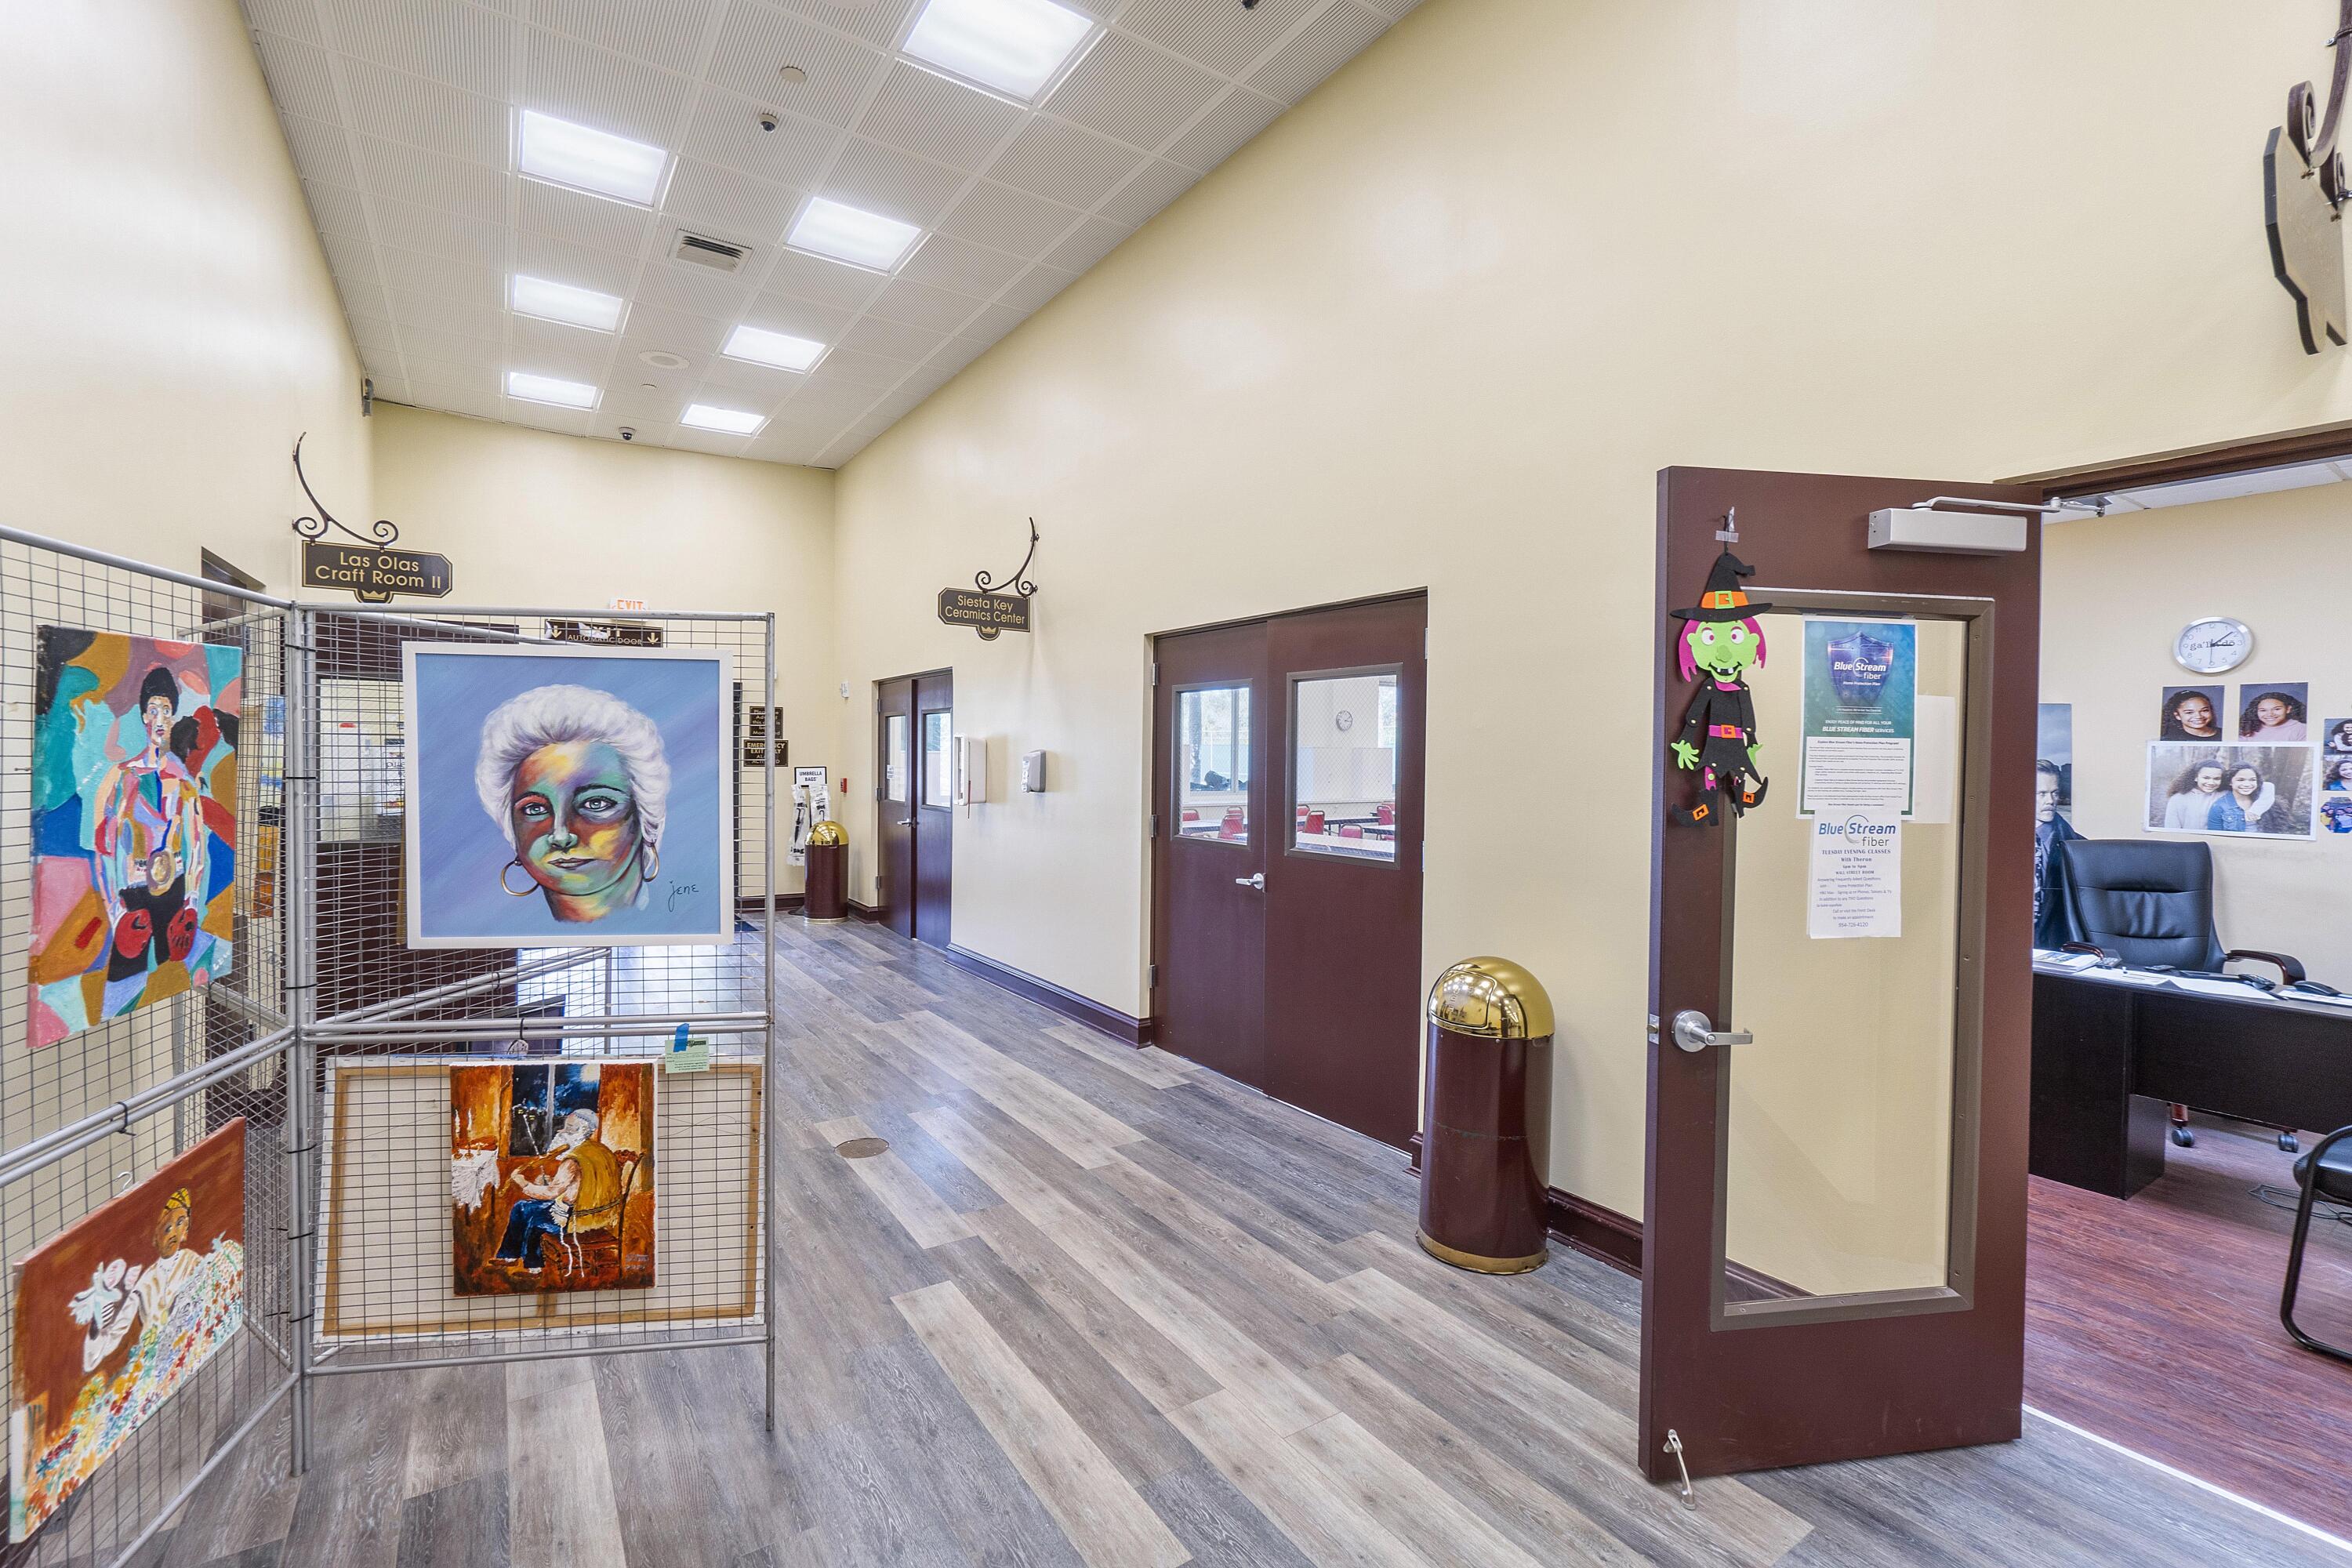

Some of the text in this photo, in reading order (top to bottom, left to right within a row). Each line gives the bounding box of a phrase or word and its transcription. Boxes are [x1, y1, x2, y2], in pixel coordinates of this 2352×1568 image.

[339, 551, 419, 572] Las Olas
[315, 565, 441, 589] Craft Room II
[957, 594, 1014, 613] Siesta Key
[945, 606, 1025, 625] Ceramics Center
[568, 634, 642, 647] AUTOMATIC DOOR
[1833, 661, 1886, 672] Blue Stream
[1818, 822, 1896, 835] Blue Stream
[1862, 836, 1889, 847] fiber
